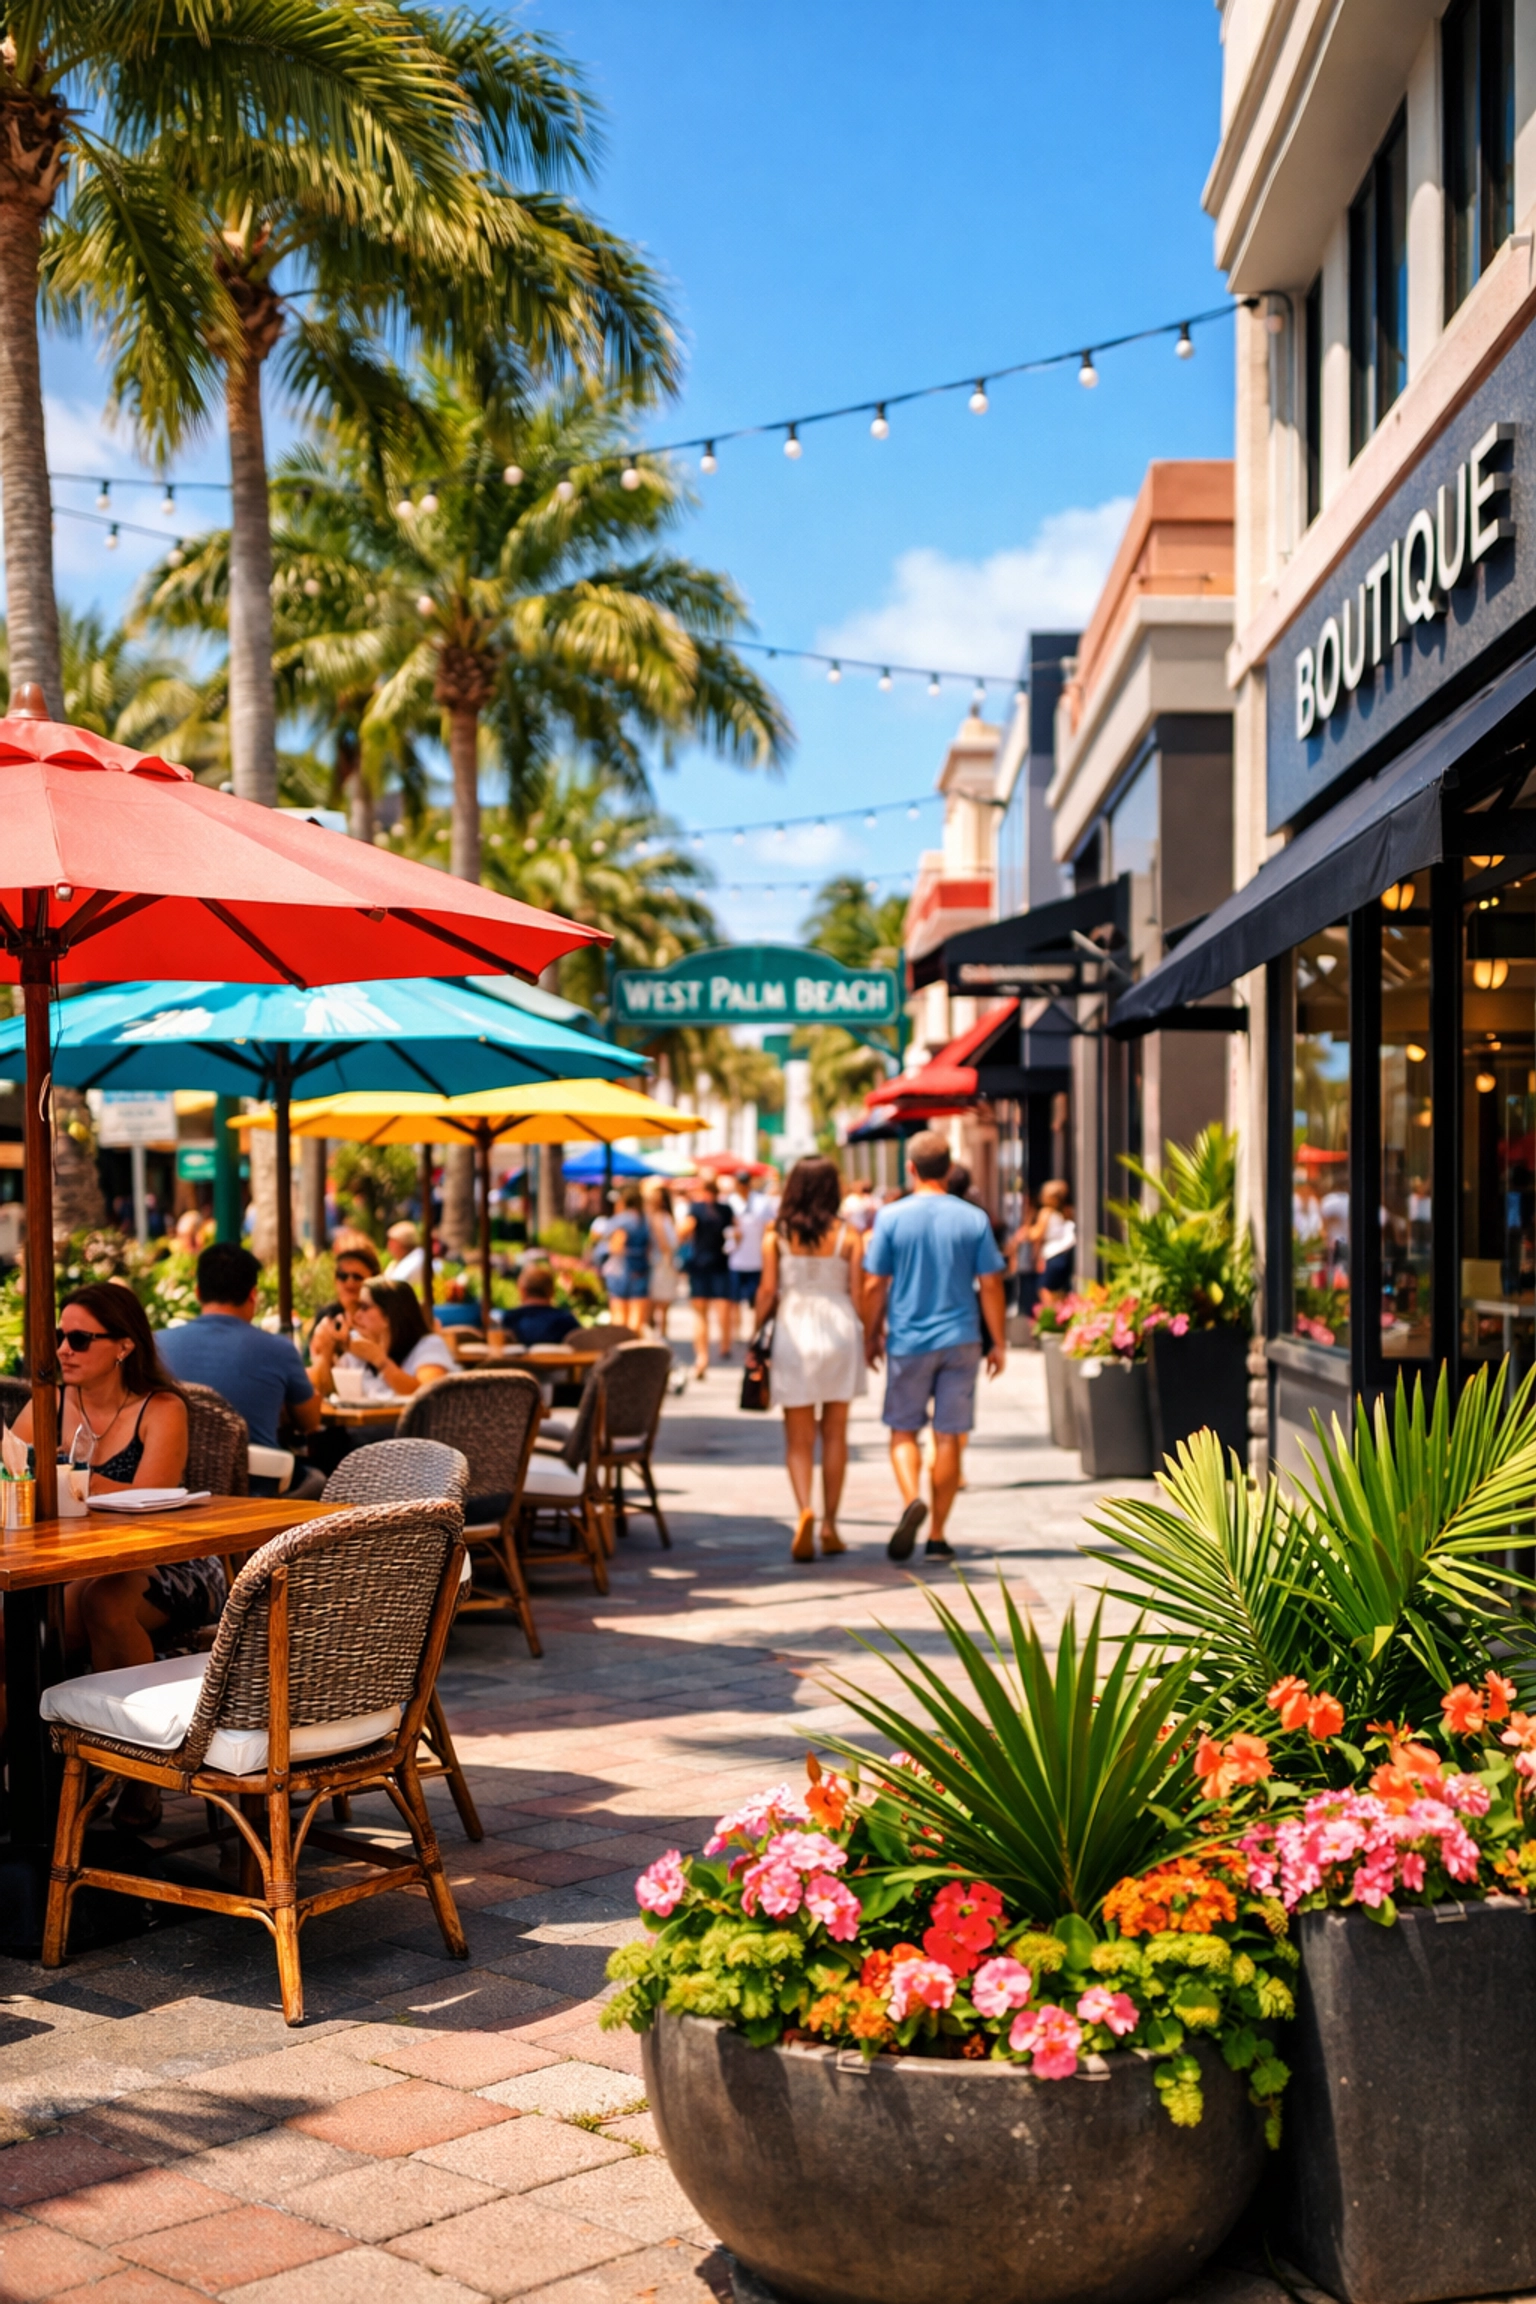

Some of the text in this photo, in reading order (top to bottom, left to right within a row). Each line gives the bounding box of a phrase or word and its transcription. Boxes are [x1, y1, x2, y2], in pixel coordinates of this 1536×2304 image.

[1296, 421, 1508, 742] BOUTIQUE
[622, 976, 888, 1013] WEST PALM BEACH
